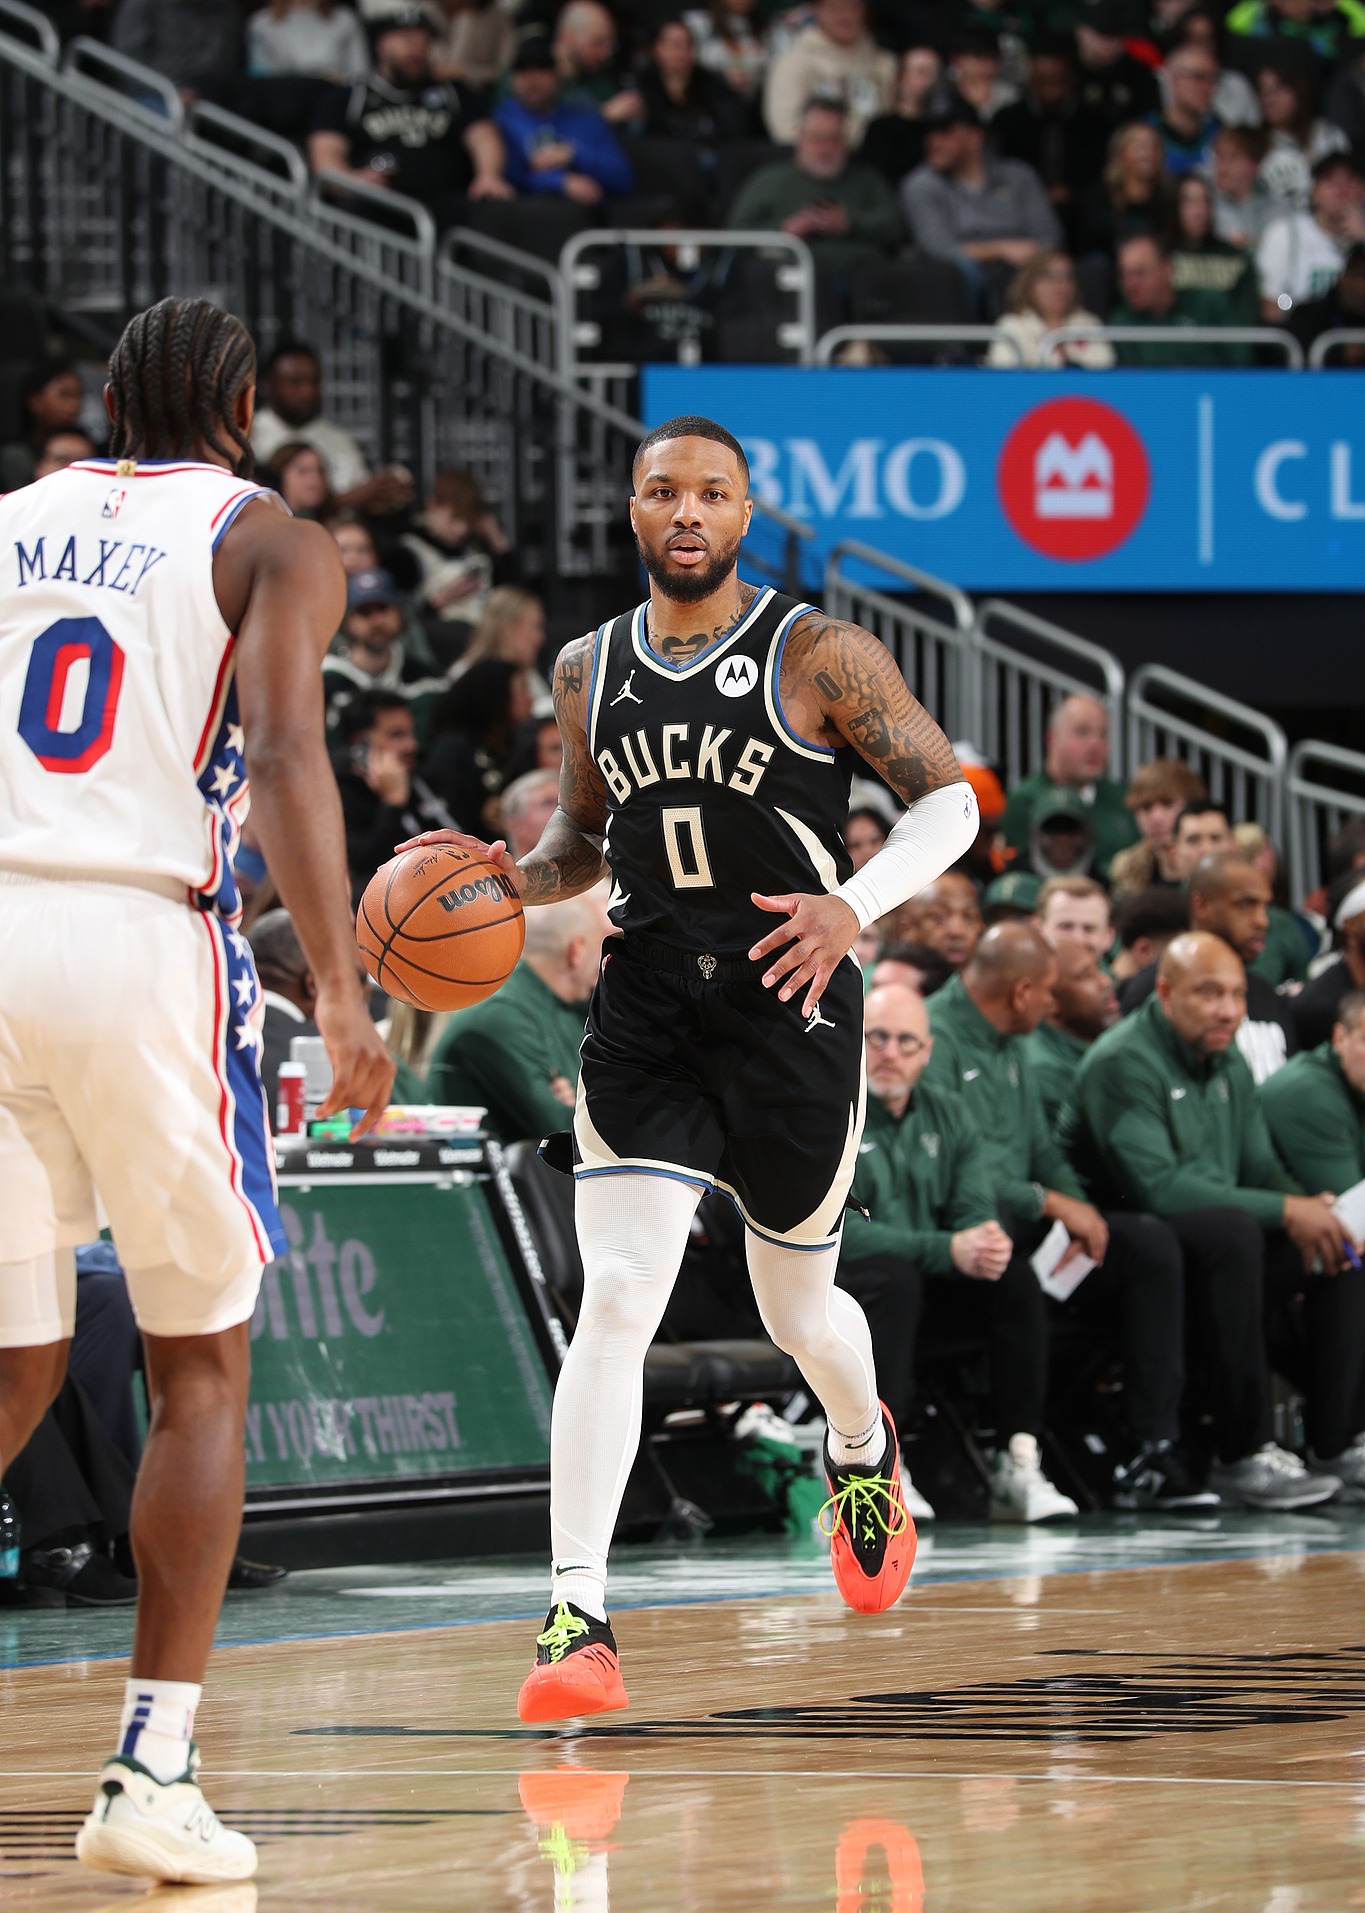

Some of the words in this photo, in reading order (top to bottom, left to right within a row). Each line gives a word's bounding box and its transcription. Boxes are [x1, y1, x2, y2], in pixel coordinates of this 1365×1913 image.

[743, 436, 967, 521] BMO
[14, 534, 167, 595] MAXEY
[17, 616, 125, 774] 0
[597, 723, 777, 806] BUCKS
[661, 804, 717, 890] 0
[249, 1203, 385, 1341] rite
[266, 1398, 357, 1462] YOUR
[353, 1391, 461, 1455] THIRST
